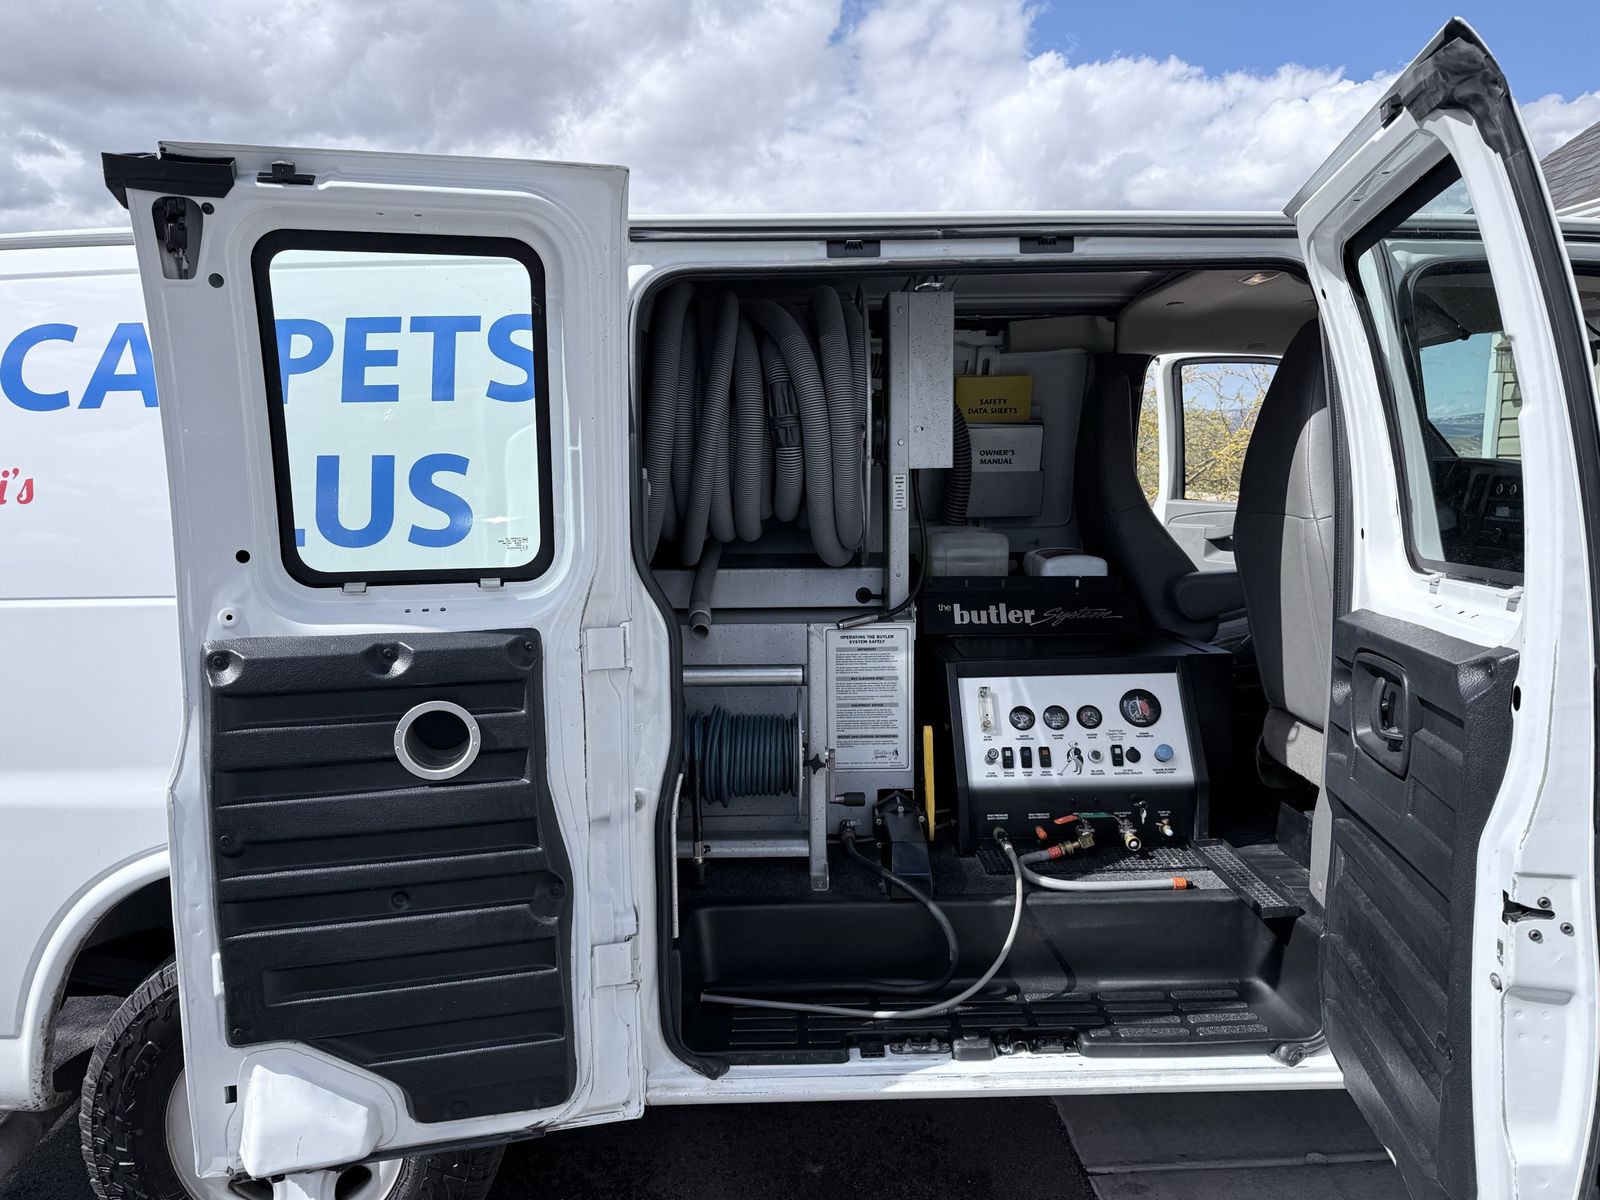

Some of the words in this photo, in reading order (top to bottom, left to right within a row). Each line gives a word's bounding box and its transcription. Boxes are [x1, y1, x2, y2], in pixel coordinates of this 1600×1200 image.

[0, 313, 535, 412] CAPETS
[295, 453, 473, 548] US
[953, 603, 1035, 624] butler
[1032, 607, 1121, 626] System
